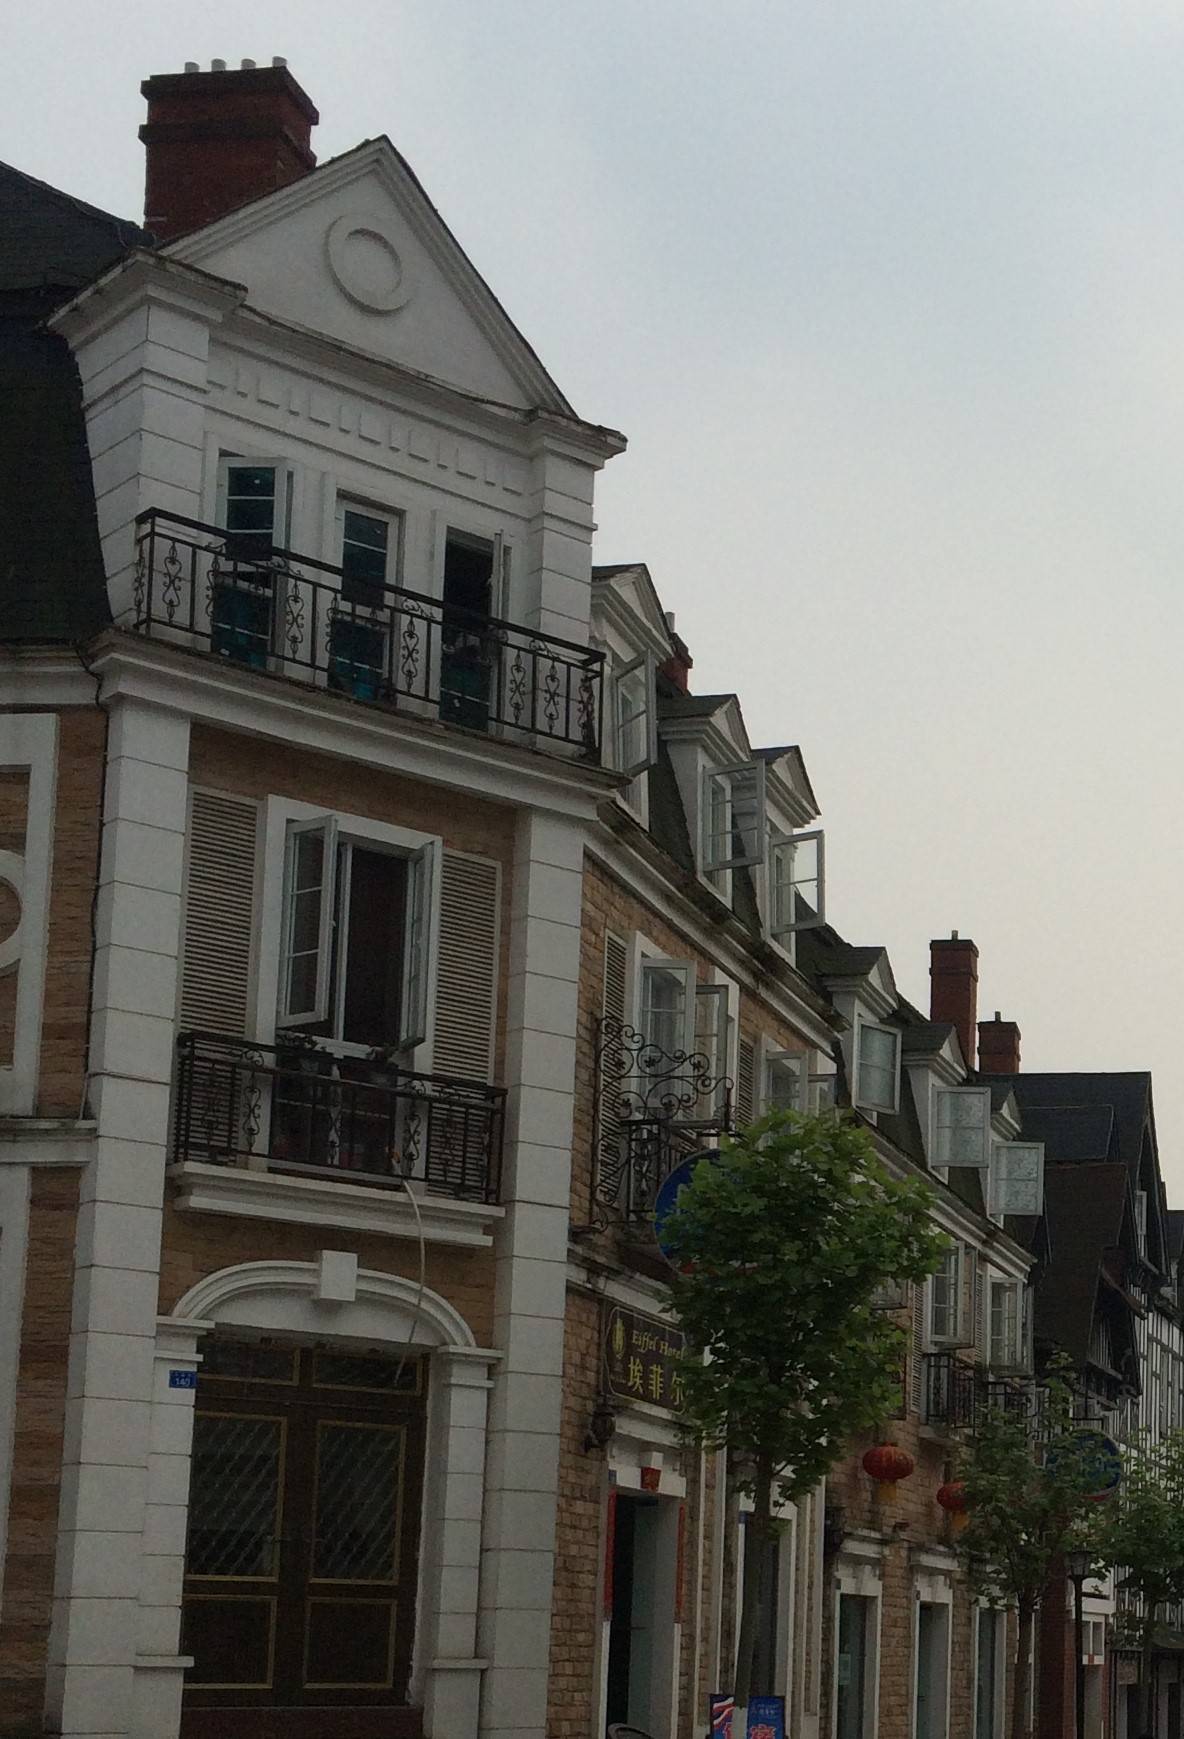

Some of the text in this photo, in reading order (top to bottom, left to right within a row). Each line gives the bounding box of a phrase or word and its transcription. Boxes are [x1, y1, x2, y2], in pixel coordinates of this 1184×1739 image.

[632, 1330, 659, 1353] Eiffel
[628, 1356, 685, 1406] 埃菲尔
